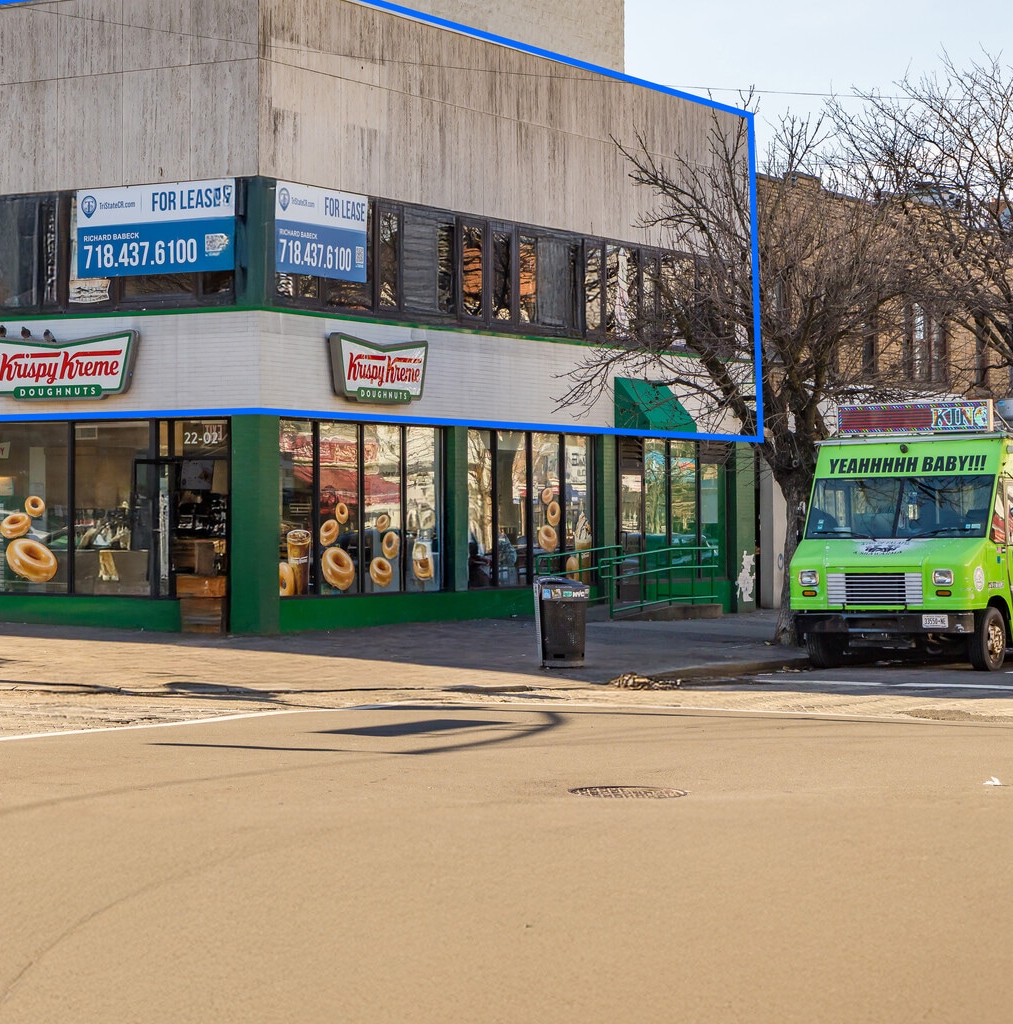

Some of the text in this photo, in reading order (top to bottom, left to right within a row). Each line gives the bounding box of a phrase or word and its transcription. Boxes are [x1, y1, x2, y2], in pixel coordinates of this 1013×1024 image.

[152, 191, 177, 212] FOR
[324, 197, 340, 218] FOR
[341, 200, 365, 222] LEASE
[83, 232, 140, 242] RICHARD BABECK
[83, 238, 197, 269] 718.437.6100
[279, 239, 352, 272] 718.437.6100
[59, 349, 123, 380] Kreme
[347, 352, 422, 387] Krispy Kreme
[20, 387, 96, 397] DOUGHNUTS
[360, 389, 407, 400] DOUGHNUTS
[184, 432, 218, 444] 22-02
[829, 455, 987, 474] YEAHHHHH BABY!!!
